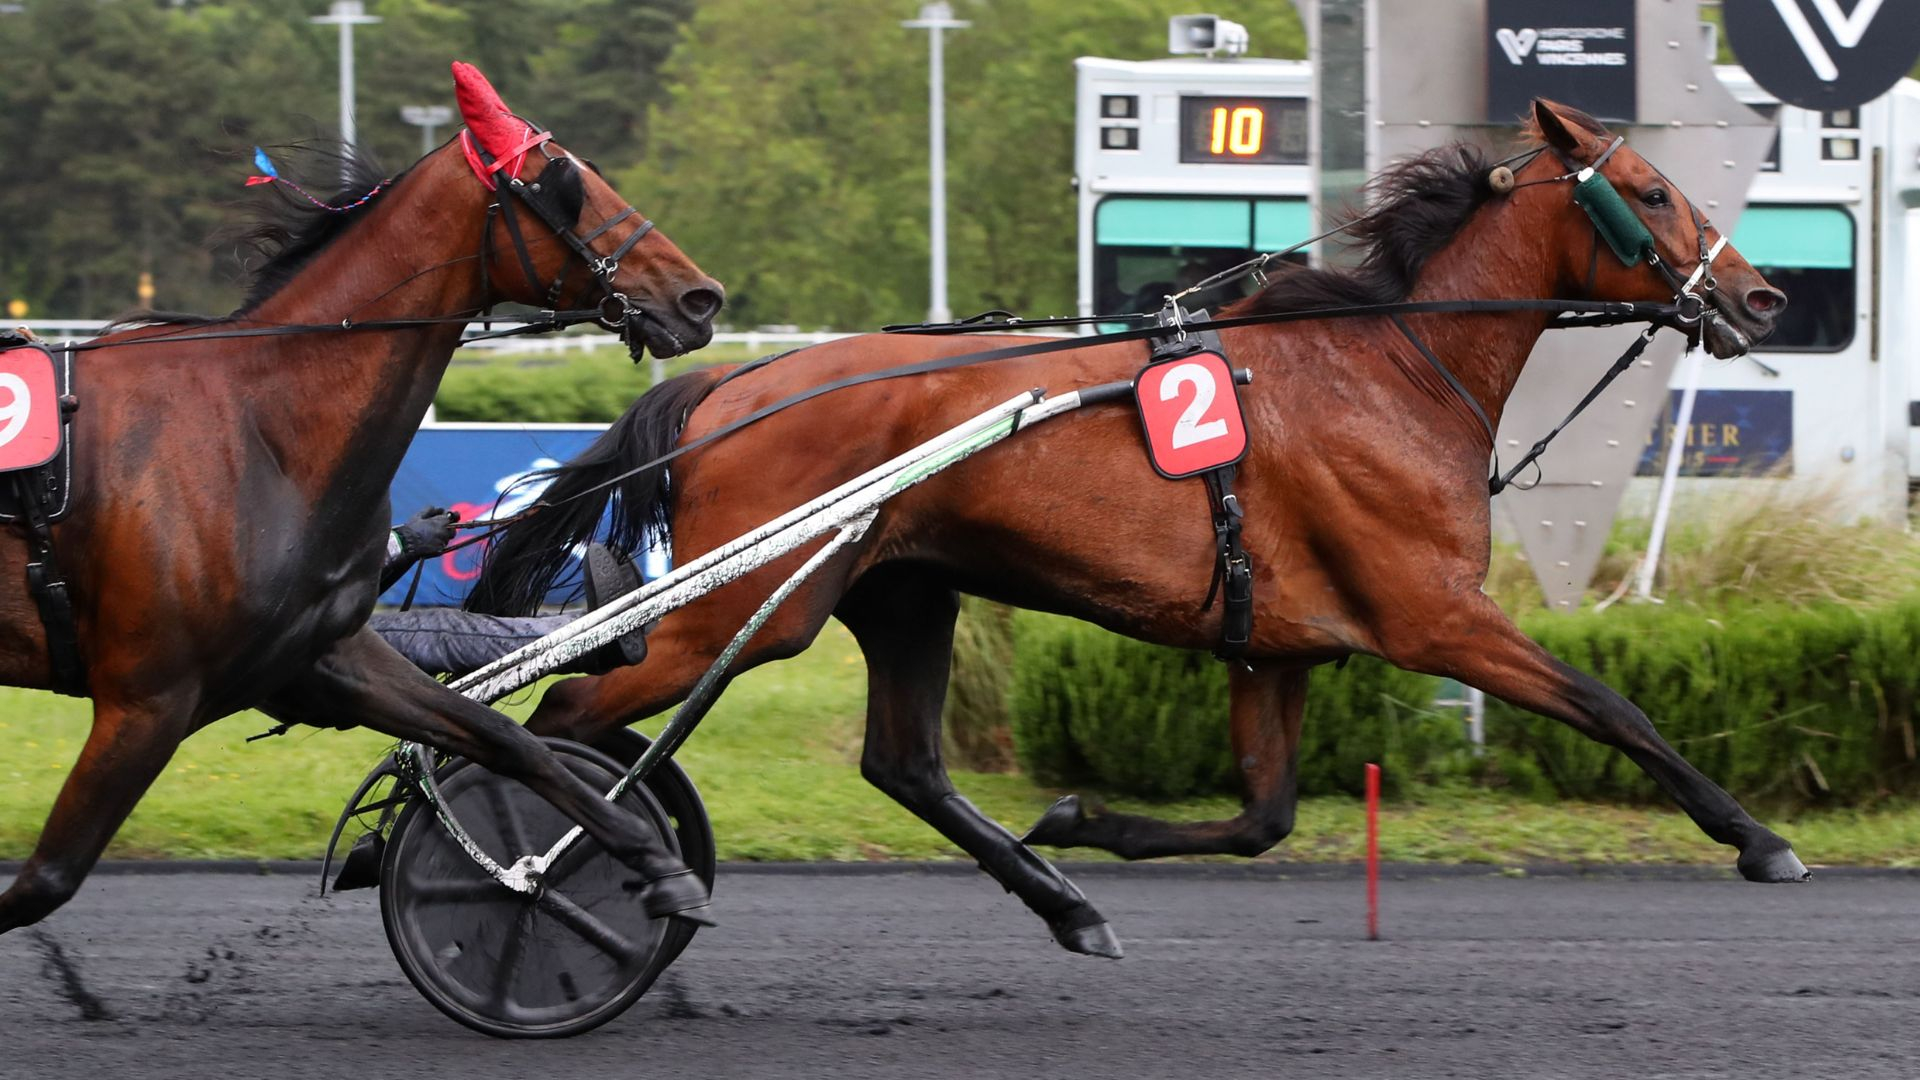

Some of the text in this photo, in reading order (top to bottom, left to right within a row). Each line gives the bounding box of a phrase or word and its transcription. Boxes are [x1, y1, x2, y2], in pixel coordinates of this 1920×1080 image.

[1211, 107, 1264, 155] 10
[0, 372, 31, 448] 9
[1159, 363, 1229, 450] 2
